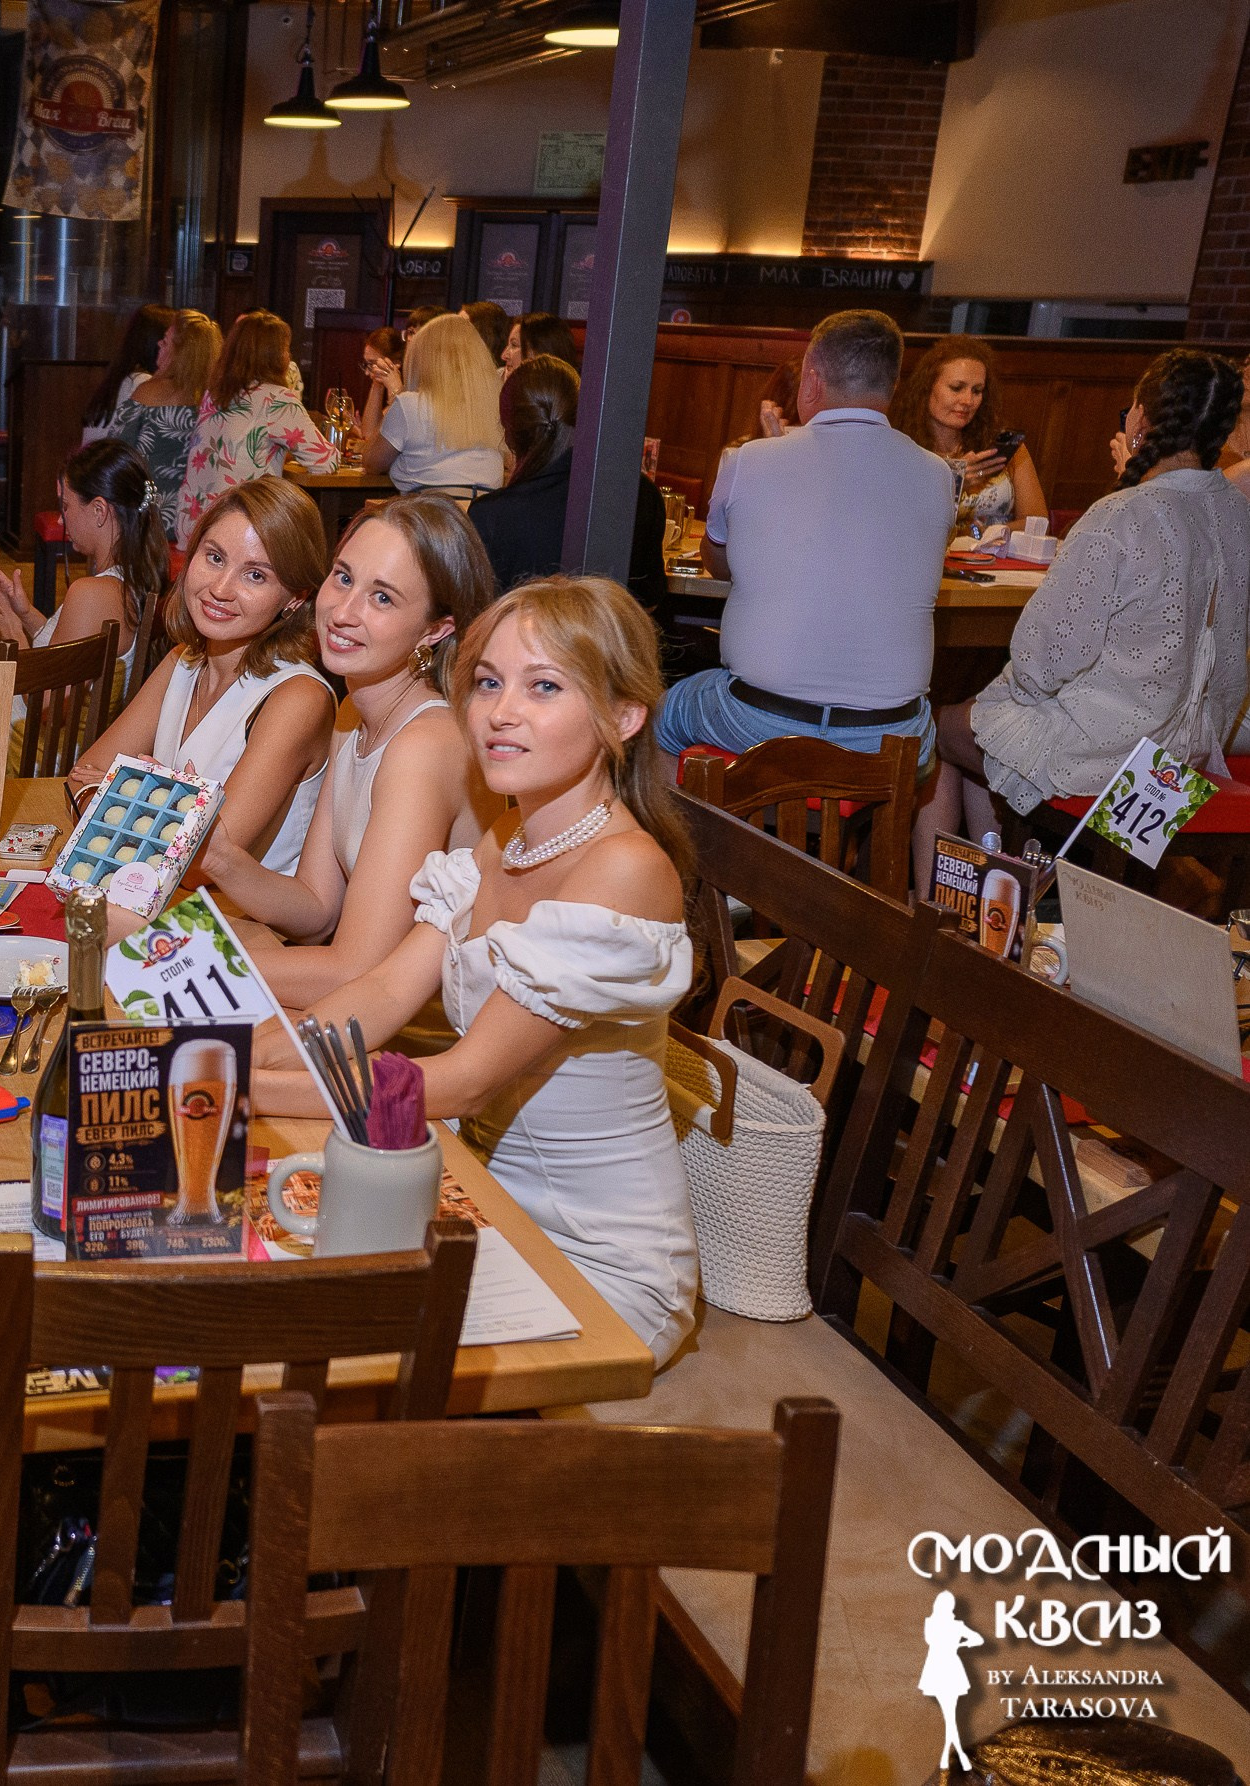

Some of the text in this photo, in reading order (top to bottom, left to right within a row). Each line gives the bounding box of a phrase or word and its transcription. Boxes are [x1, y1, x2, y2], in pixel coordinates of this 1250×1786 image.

[760, 266, 800, 284] MAX
[1144, 783, 1160, 799] СТОЛ
[1111, 792, 1166, 845] 412
[937, 855, 978, 879] СЕВЕРО-
[936, 870, 979, 895] НЕМЕЦКИЙ
[935, 883, 977, 919] ПИЛС
[160, 961, 184, 982] СТОЛ
[163, 964, 240, 1025] 411
[82, 1030, 159, 1049] ВСТРЕЧАЙТЕ!
[79, 1048, 158, 1074] СЕВЕРО-
[80, 1066, 159, 1093] НЕМЕЦКИЙ
[80, 1088, 160, 1126] ПИЛС
[85, 1123, 154, 1140] ЕВЕР ПИЛС
[76, 1193, 161, 1212] ЛИМИТИРОВАННОЕ!
[88, 1217, 154, 1232] ПОПРОБОВАТЬ
[89, 1231, 105, 1241] ЕГО
